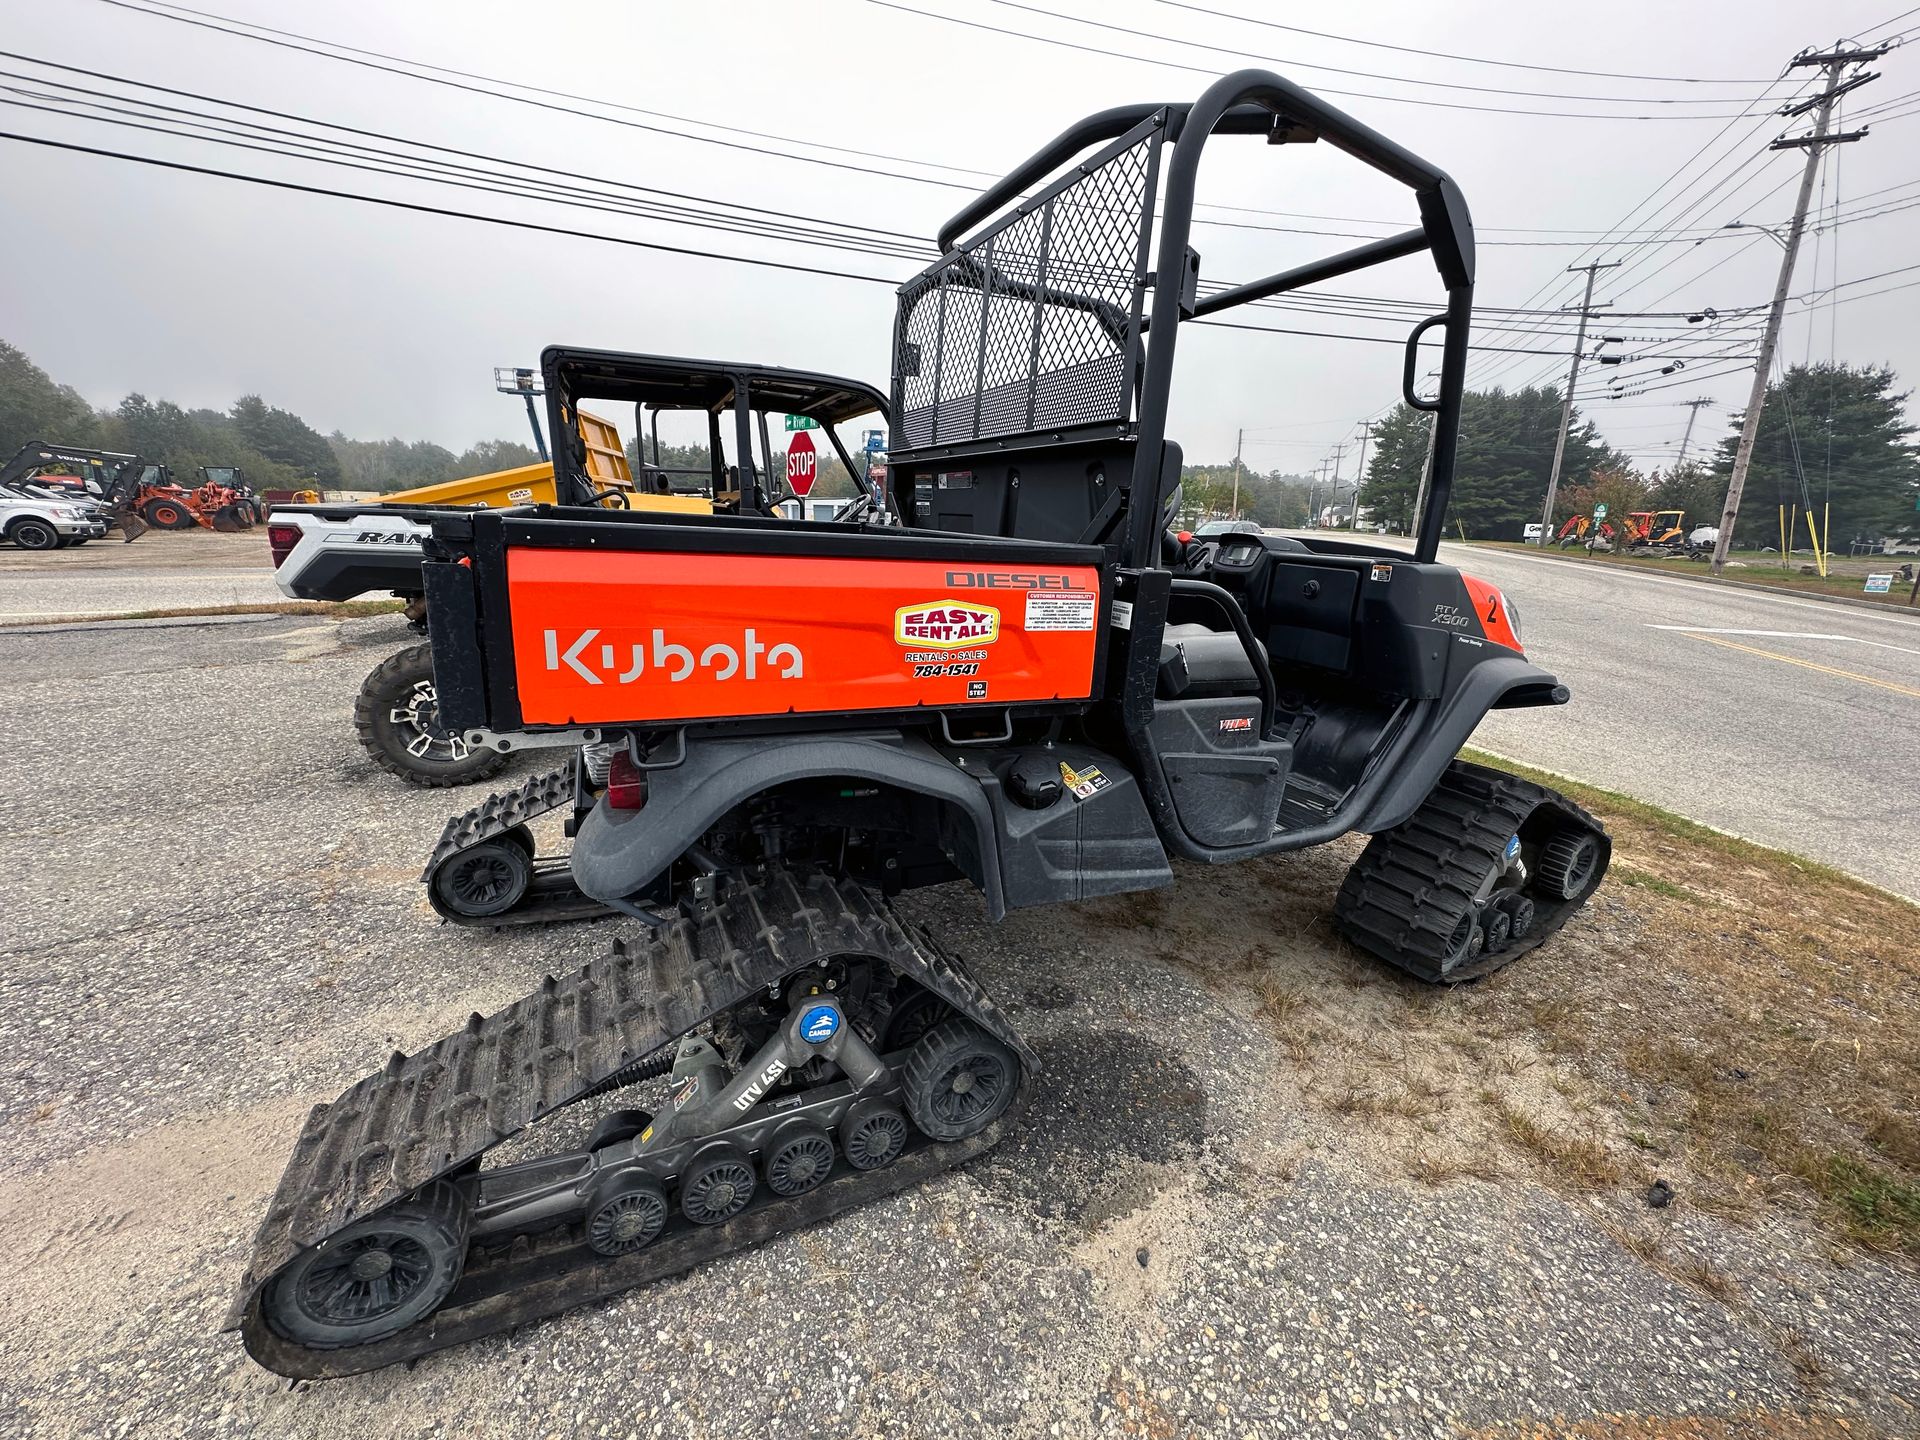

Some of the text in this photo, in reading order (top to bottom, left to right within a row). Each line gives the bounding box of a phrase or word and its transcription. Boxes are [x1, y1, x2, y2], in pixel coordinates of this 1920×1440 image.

[56, 454, 87, 463] VOLVO
[789, 452, 814, 476] STOP
[946, 572, 1086, 590] DIESEL
[1435, 605, 1458, 614] RTV
[1487, 595, 1497, 623] 2
[906, 610, 989, 624] EASY
[1432, 613, 1469, 627] X900
[543, 628, 803, 685] Kubota
[905, 650, 987, 662] RENTALS SALES
[914, 664, 978, 677] 784-1541
[809, 1029, 831, 1037] CAMSO
[733, 1082, 763, 1111] UTV
